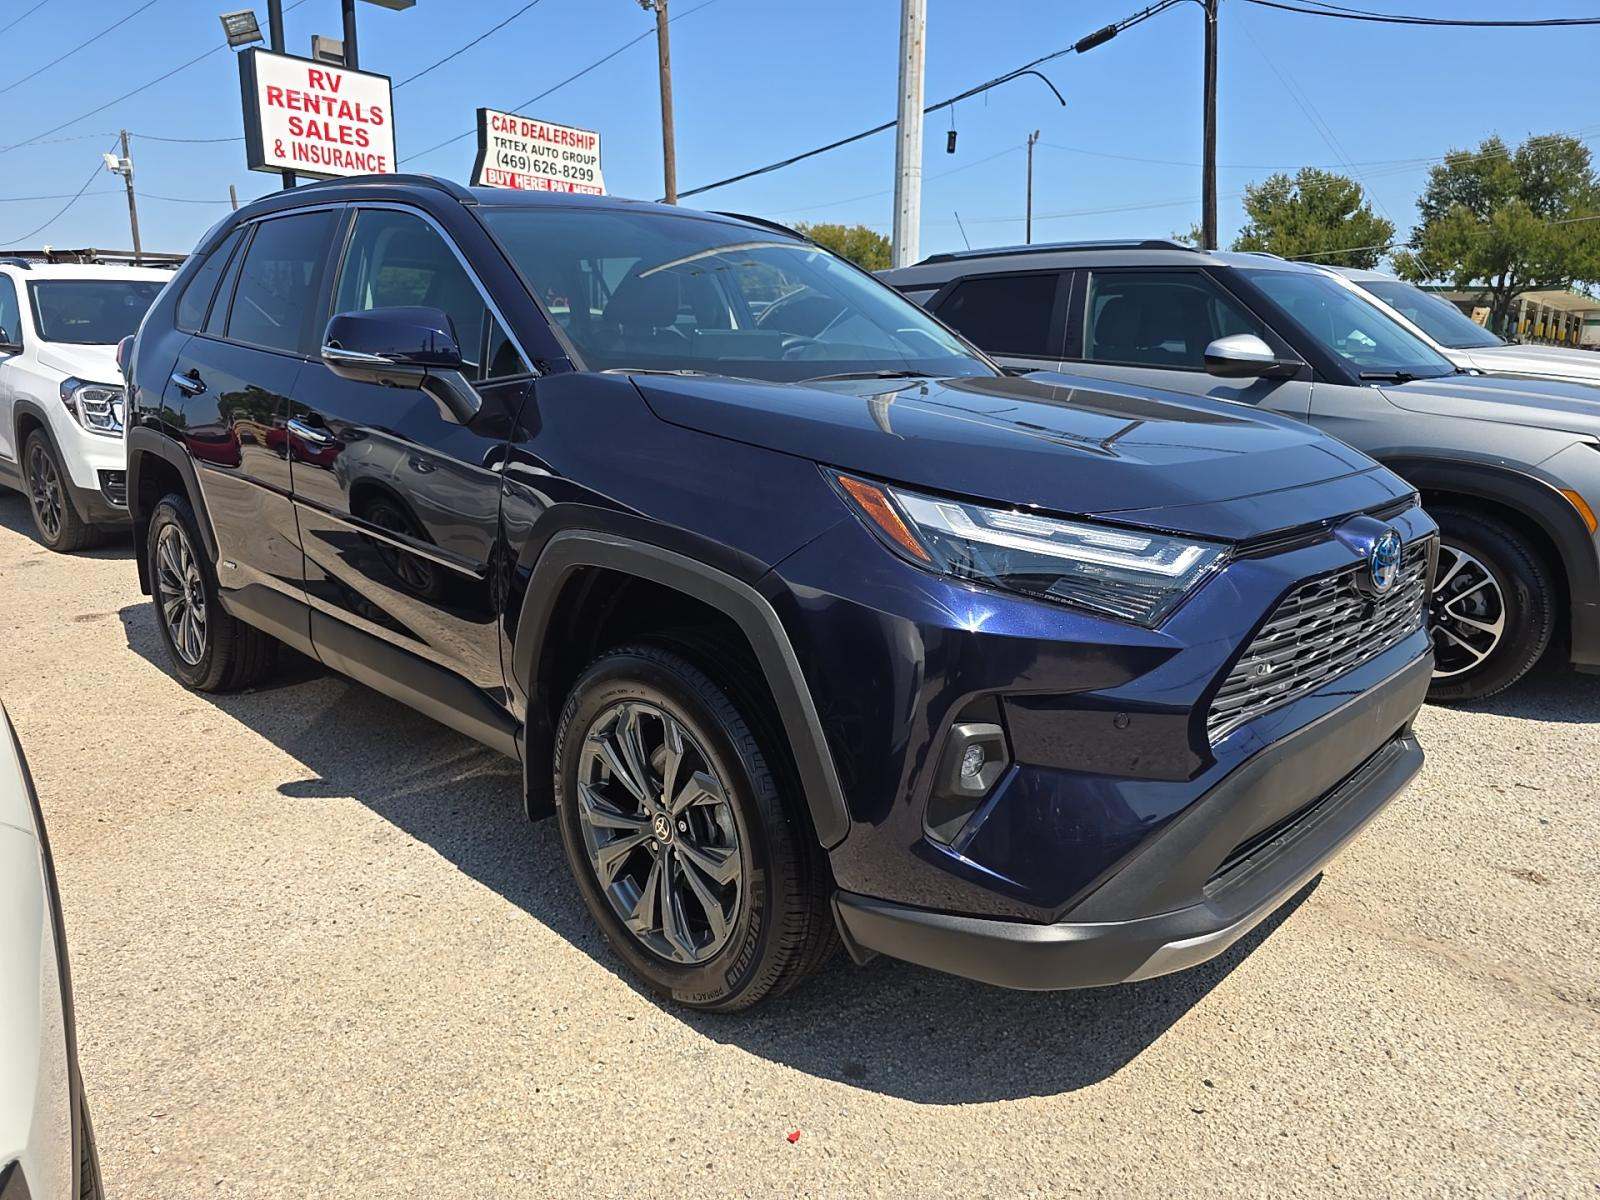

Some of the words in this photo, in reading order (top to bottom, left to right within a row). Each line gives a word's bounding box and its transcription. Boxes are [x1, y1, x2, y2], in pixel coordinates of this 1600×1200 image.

[308, 68, 342, 93] RV
[266, 85, 384, 126] RENTALS
[288, 116, 370, 148] SALES
[491, 115, 517, 135] CAR
[521, 121, 596, 150] DEALERSHIP
[274, 138, 286, 158] &
[292, 141, 386, 173] INSURANCE
[493, 136, 528, 153] TRTEX
[531, 145, 559, 159] AUTO
[562, 151, 597, 166] GROUP
[496, 149, 531, 173] (469)
[533, 159, 594, 182] 626-8299
[487, 169, 512, 187] BUY
[550, 180, 571, 193] PAY
[726, 910, 761, 986] MICHELIN
